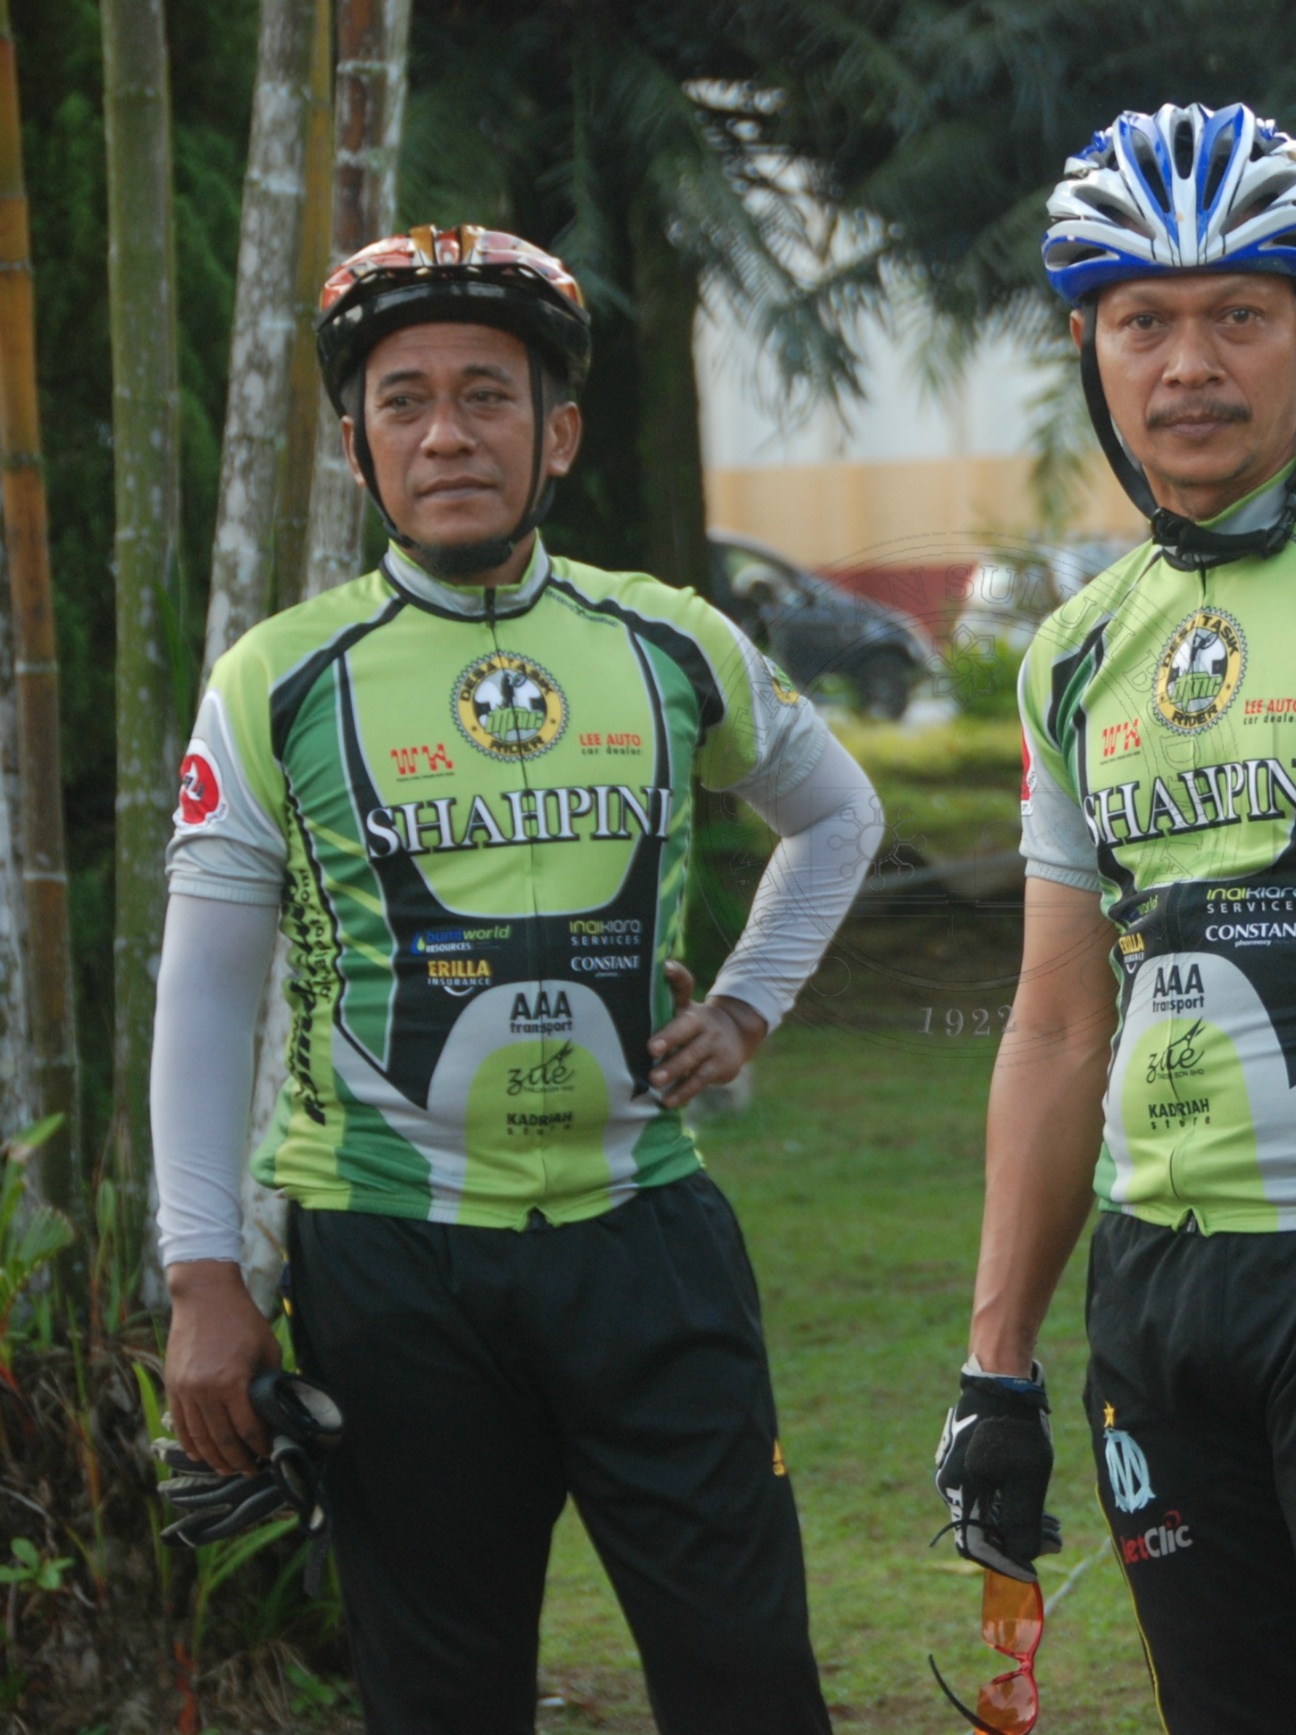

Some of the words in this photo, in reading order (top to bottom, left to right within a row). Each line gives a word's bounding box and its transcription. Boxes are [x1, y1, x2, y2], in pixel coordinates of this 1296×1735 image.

[1201, 614, 1240, 657] TASIK
[459, 660, 498, 702] DESA
[1171, 704, 1219, 726] RIDER
[1244, 700, 1264, 715] LEE
[1243, 715, 1259, 726] car
[488, 735, 545, 756] RIDER
[579, 733, 603, 747] LEE
[606, 733, 642, 747] AUTO
[366, 784, 673, 859] SHAHPINI
[426, 942, 472, 953] RESOURCES
[571, 935, 640, 946] SERVICES
[427, 959, 491, 978] ERILLA
[570, 955, 641, 972] CONSTANT
[428, 977, 491, 986] INSURANCE
[1152, 963, 1205, 999] AAA
[510, 990, 573, 1021] AAA
[509, 1019, 573, 1035] transport
[1148, 1098, 1210, 1120] KADRIAH
[506, 1112, 573, 1126] KADRIAH
[1151, 1115, 1210, 1130] store
